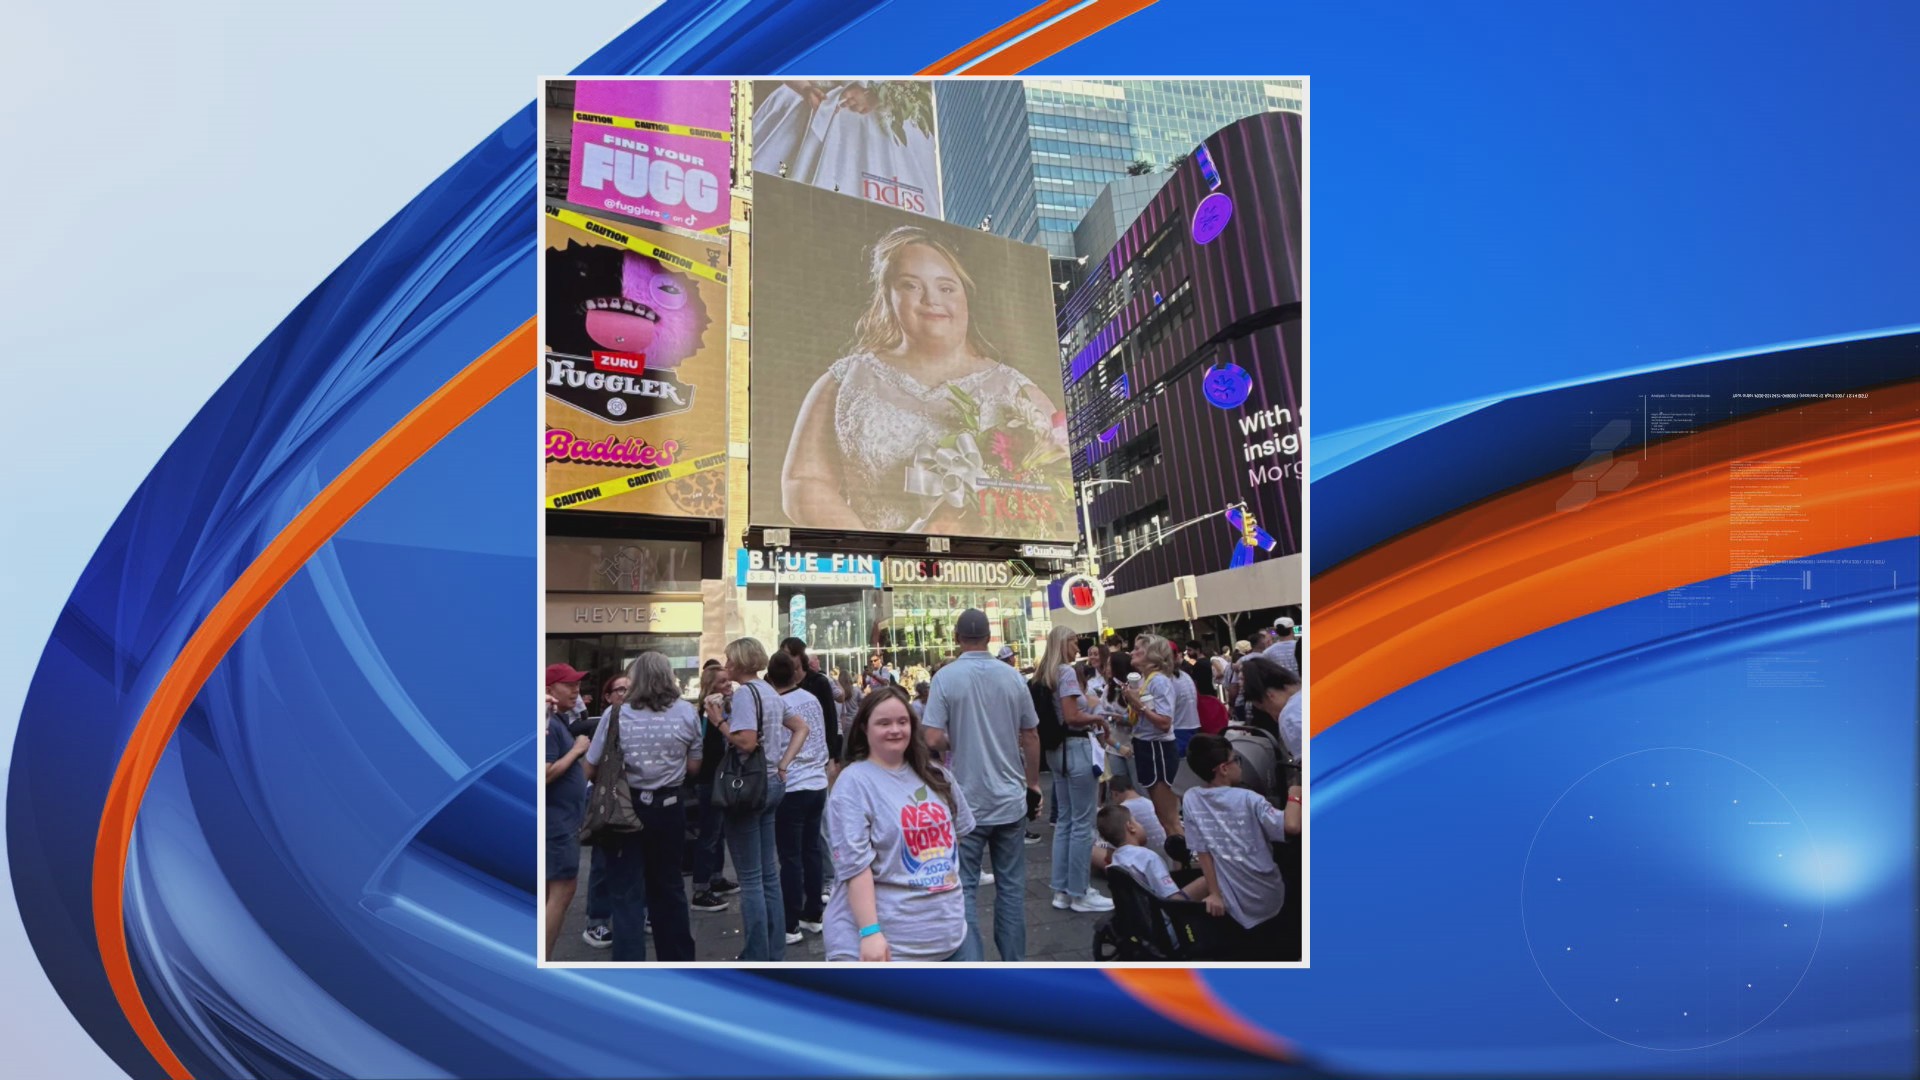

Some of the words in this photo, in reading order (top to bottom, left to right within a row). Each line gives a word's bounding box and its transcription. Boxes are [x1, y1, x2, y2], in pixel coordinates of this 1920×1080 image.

[576, 113, 614, 124] CAUTION
[635, 121, 670, 132] CAUTION
[689, 128, 722, 139] CAUTION
[603, 134, 649, 153] FIND
[653, 146, 704, 166] YOUR
[581, 142, 718, 214] FUGG
[604, 198, 661, 218] @fugglers
[585, 221, 629, 244] CAUTION
[652, 248, 693, 270] CAUTION
[600, 355, 639, 369] ZURU
[1238, 404, 1292, 436] With
[1243, 430, 1301, 462] insig
[553, 487, 602, 508] CAUTION
[627, 468, 672, 488] CAUTION
[1248, 461, 1302, 488] Morg
[748, 549, 819, 572] BLUE
[831, 552, 874, 574] FIN
[891, 560, 928, 581] DOS
[933, 561, 1008, 584] CAMINOS
[834, 574, 874, 584] SUSHI
[575, 607, 661, 623] HEYTEA
[901, 802, 947, 829] NEW
[903, 820, 953, 857] YORK
[923, 861, 951, 875] 2026
